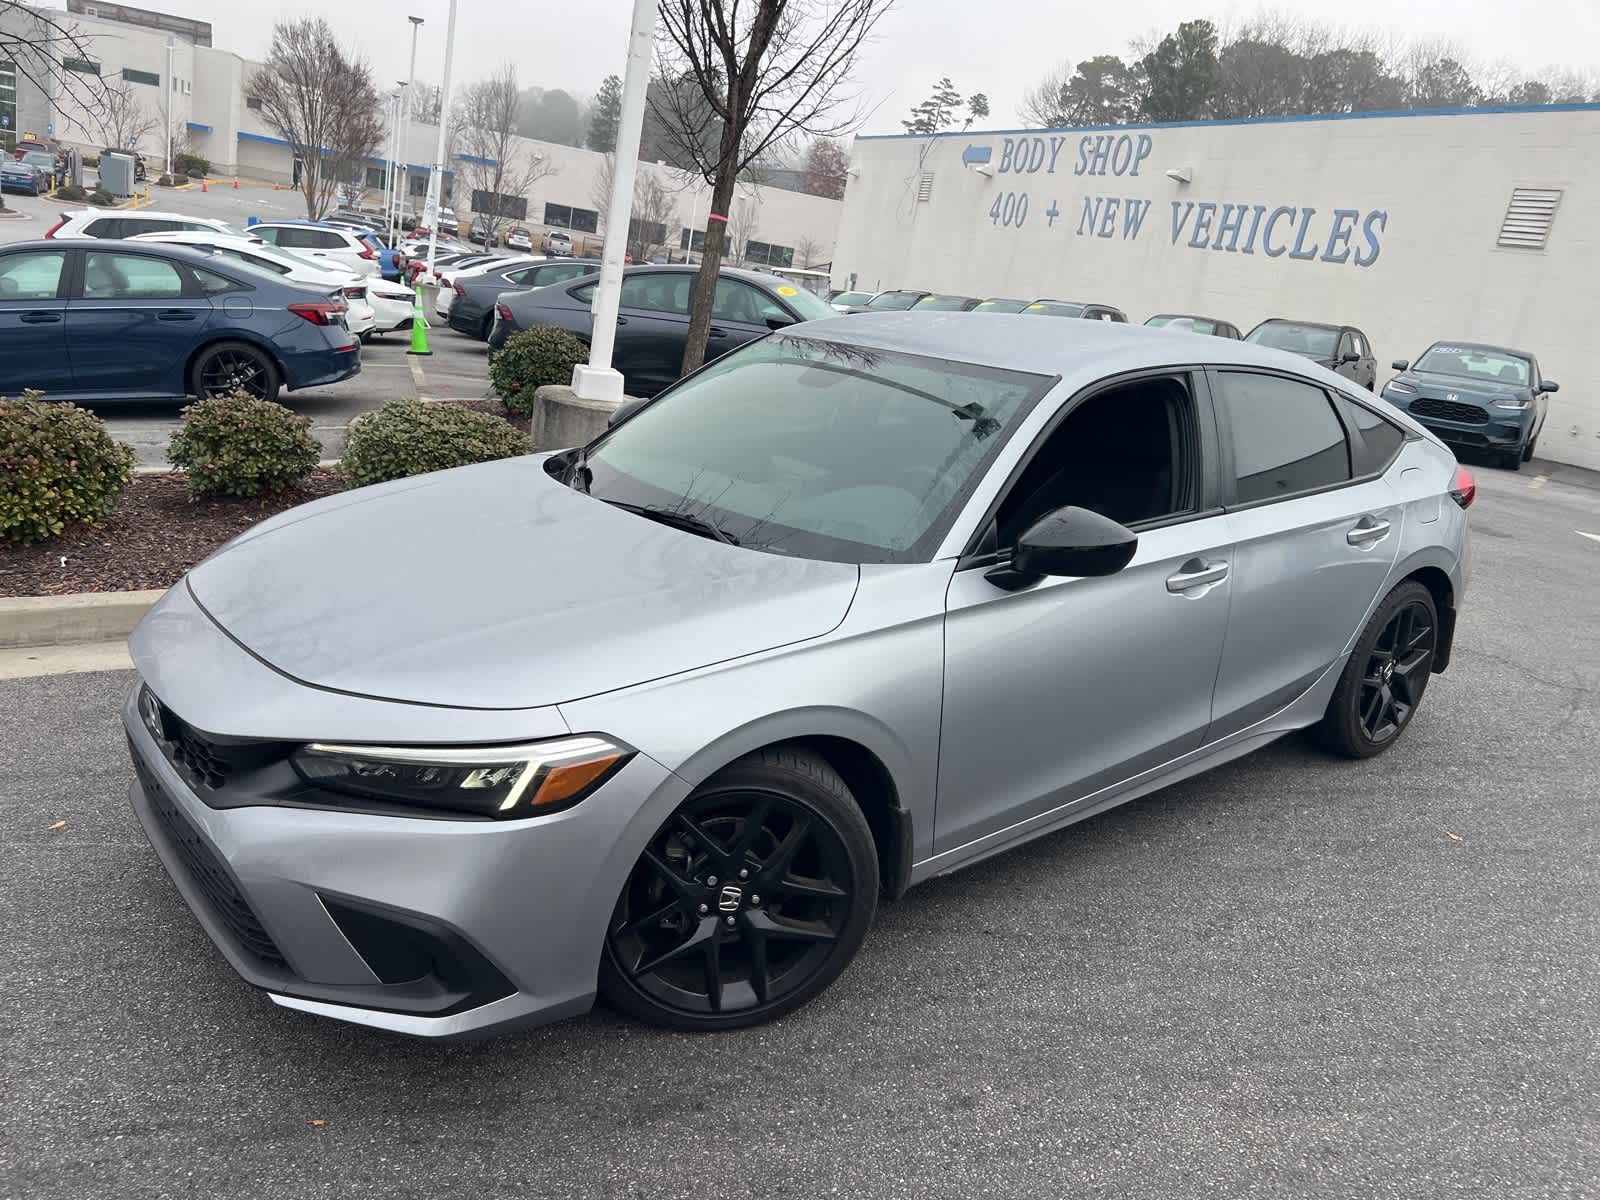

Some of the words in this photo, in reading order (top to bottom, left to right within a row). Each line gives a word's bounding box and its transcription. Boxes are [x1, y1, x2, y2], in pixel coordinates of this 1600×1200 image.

[999, 136, 1066, 174] BODY
[1074, 134, 1153, 176] SHOP
[989, 191, 1028, 228] 400
[1076, 196, 1152, 241] NEW
[1170, 201, 1388, 267] VEHICLES
